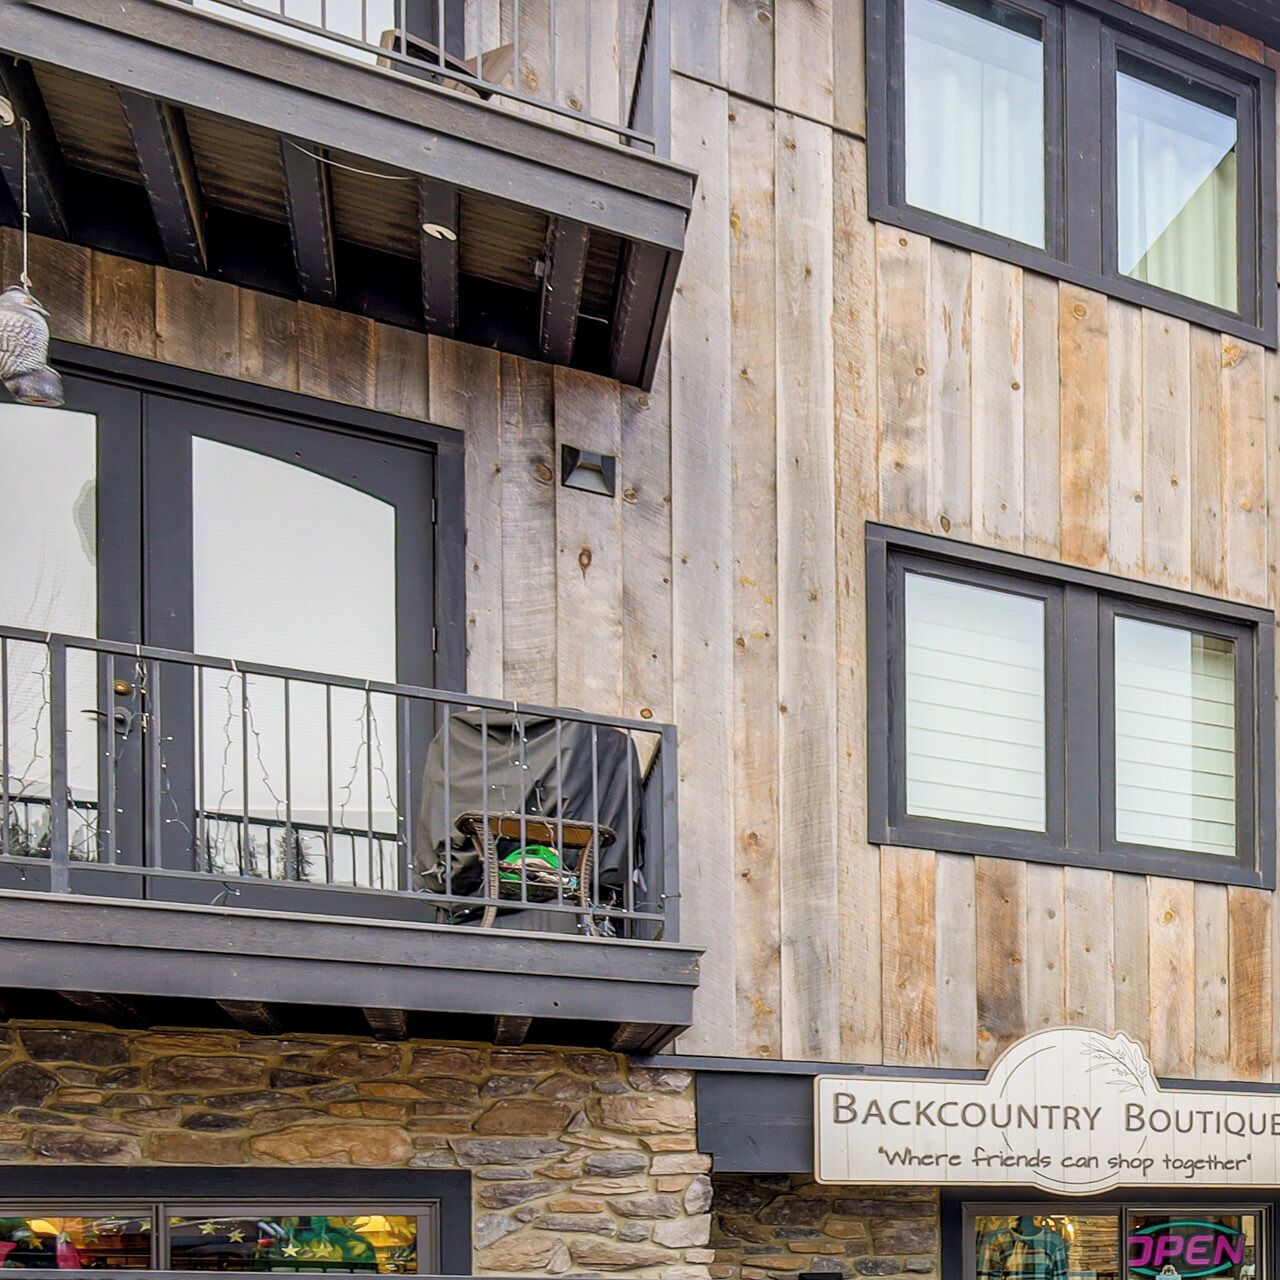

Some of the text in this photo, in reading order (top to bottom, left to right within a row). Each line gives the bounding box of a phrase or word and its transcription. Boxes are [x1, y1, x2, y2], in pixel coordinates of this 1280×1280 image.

[832, 1092, 1102, 1131] BACKCOUNTRY
[972, 1147, 1052, 1169] friends
[1060, 1154, 1099, 1169] can
[1107, 1152, 1154, 1177] shop
[1128, 1234, 1244, 1267] OPEN
